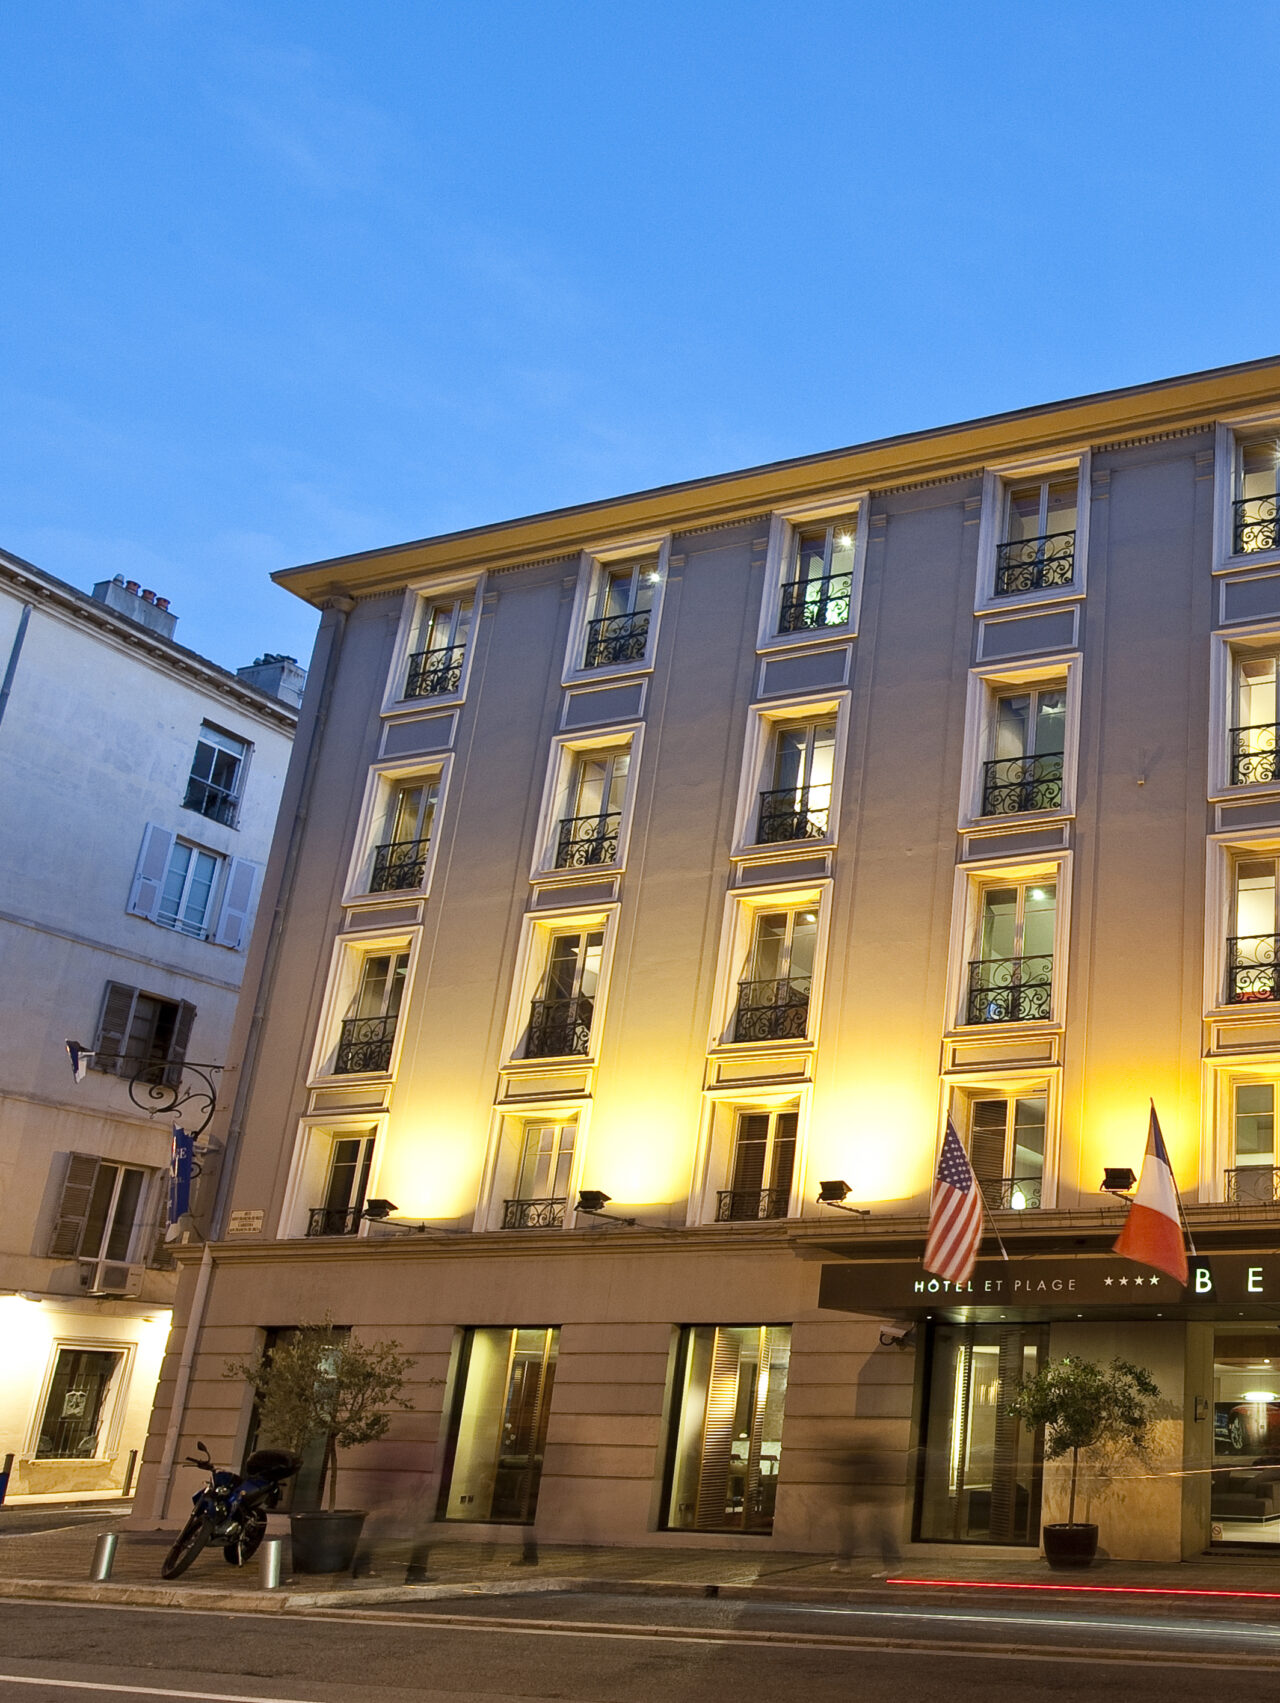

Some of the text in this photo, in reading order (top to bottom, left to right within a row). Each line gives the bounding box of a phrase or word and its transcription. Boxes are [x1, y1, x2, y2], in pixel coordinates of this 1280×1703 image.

[914, 1278, 1076, 1293] HÔTEL ET PLAGE
